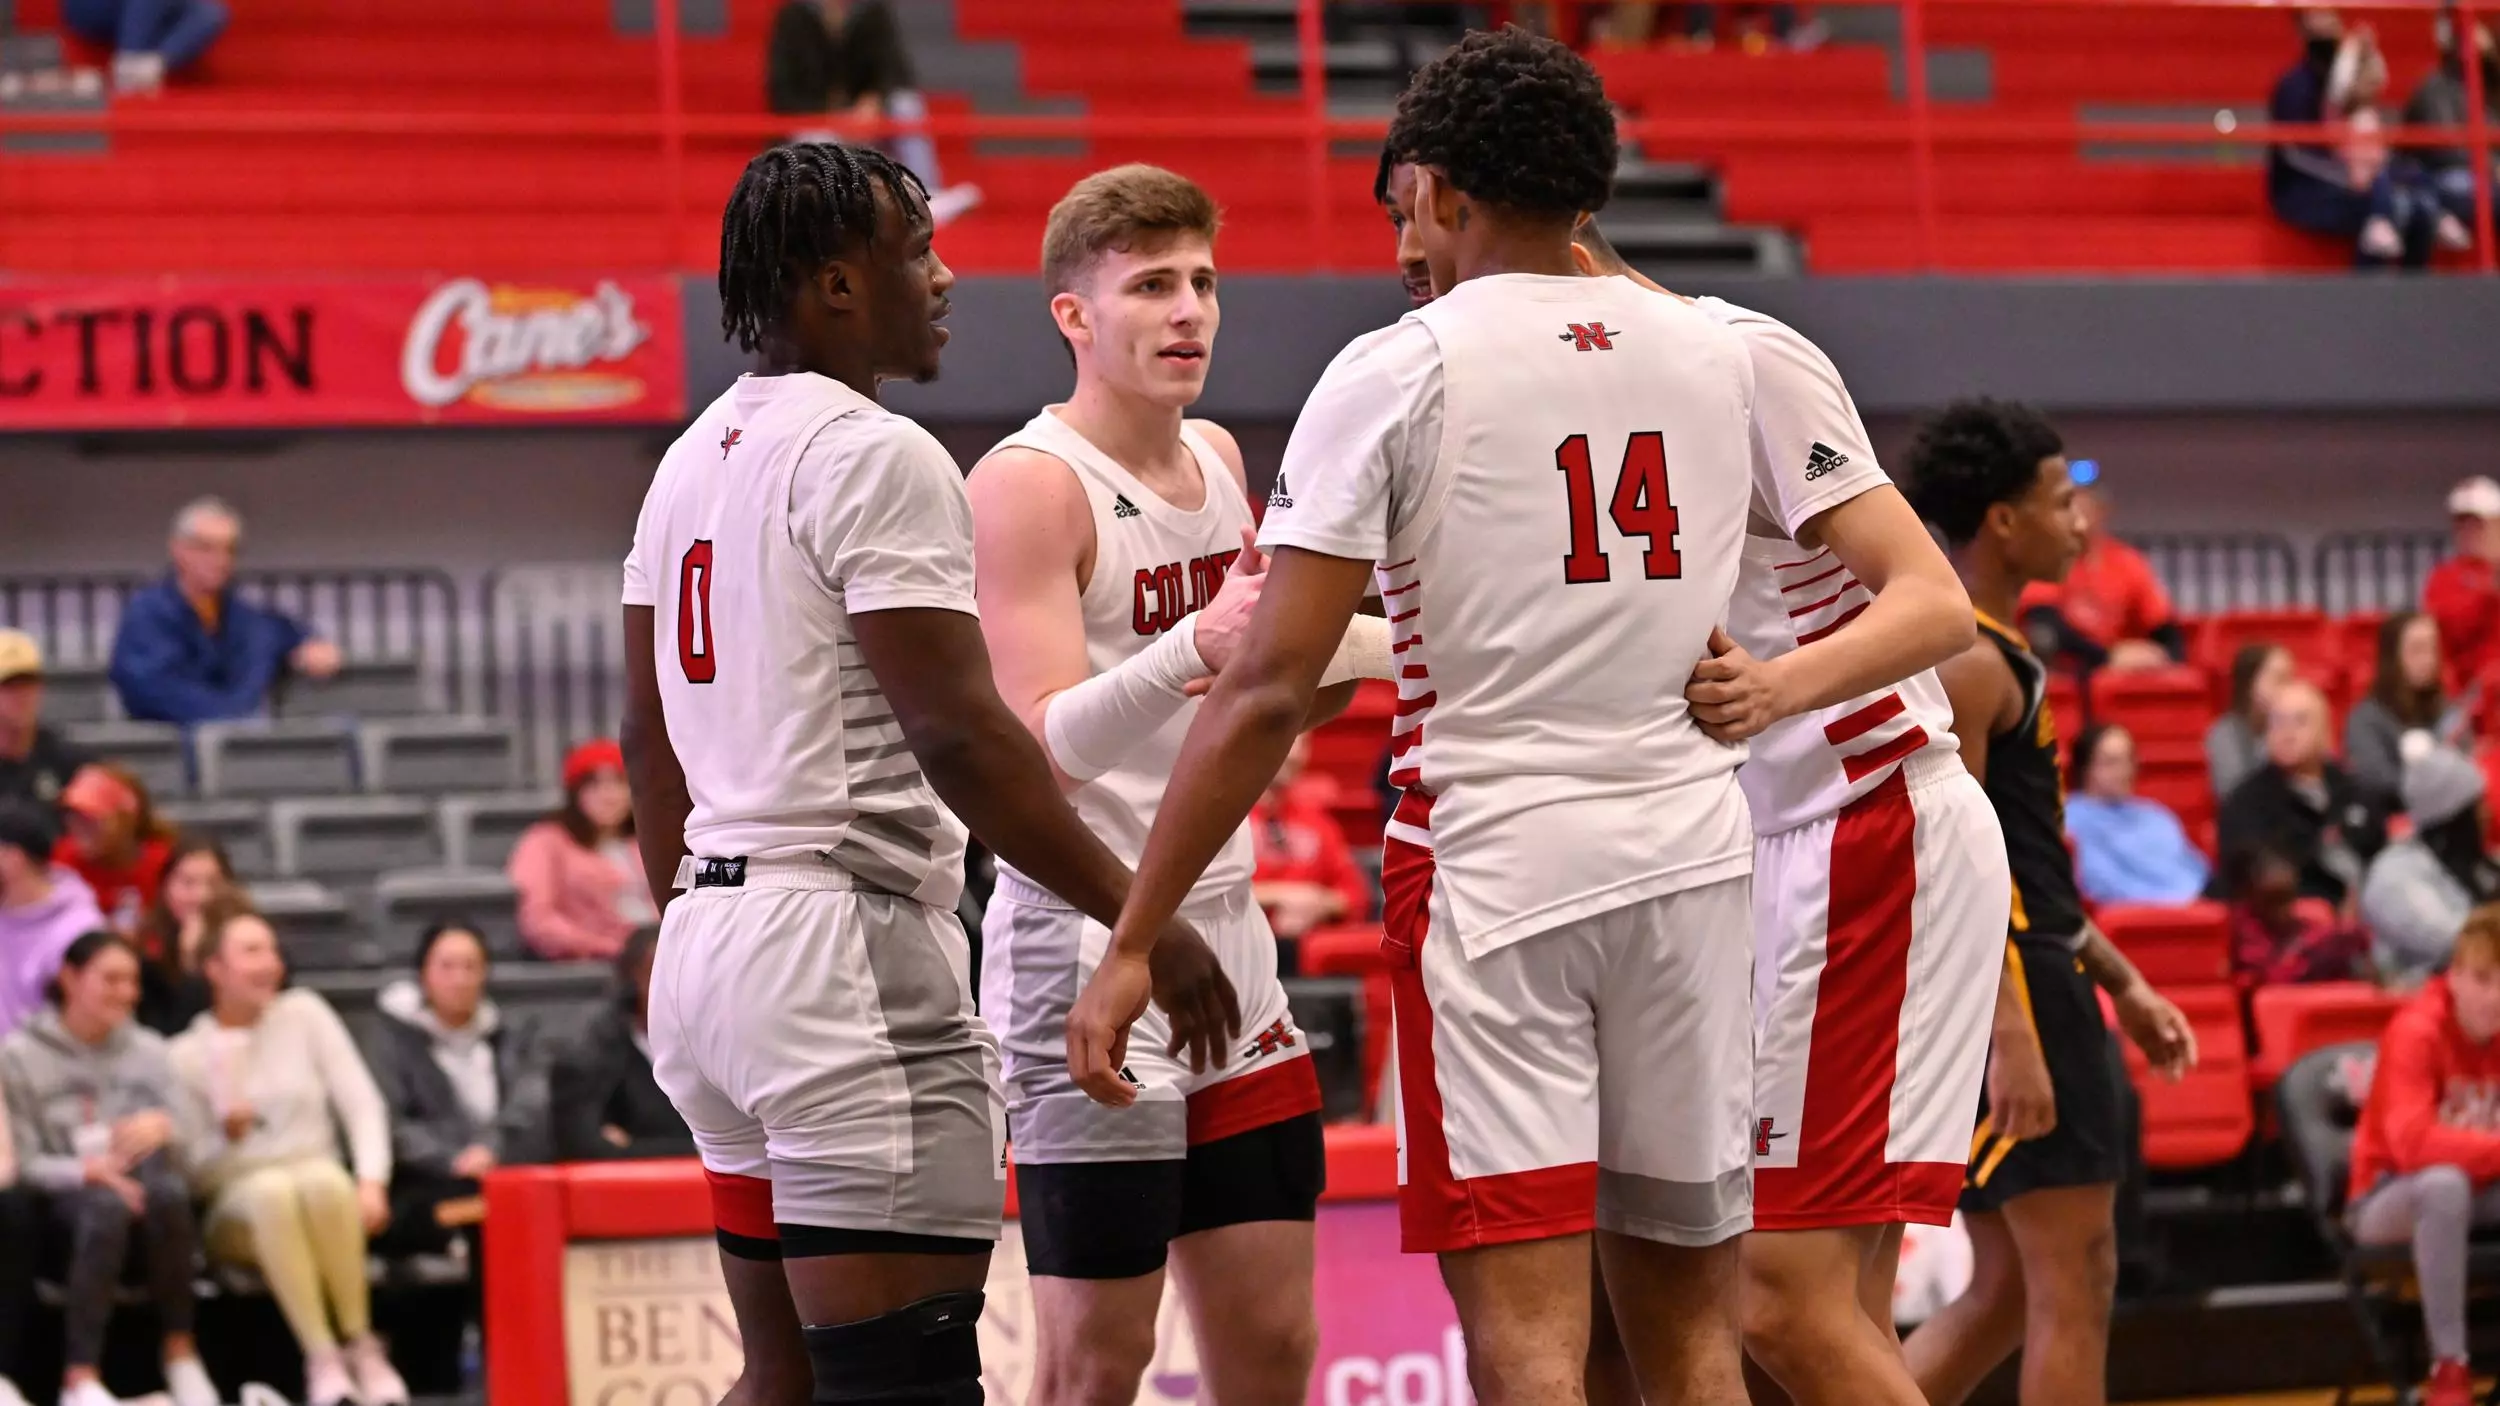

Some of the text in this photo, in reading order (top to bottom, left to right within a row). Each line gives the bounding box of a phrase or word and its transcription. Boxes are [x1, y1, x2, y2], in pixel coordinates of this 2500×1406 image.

[1555, 431, 1682, 584] 14
[1804, 453, 1849, 482] adidas
[678, 538, 716, 684] 0
[1132, 547, 1242, 636] COLON
